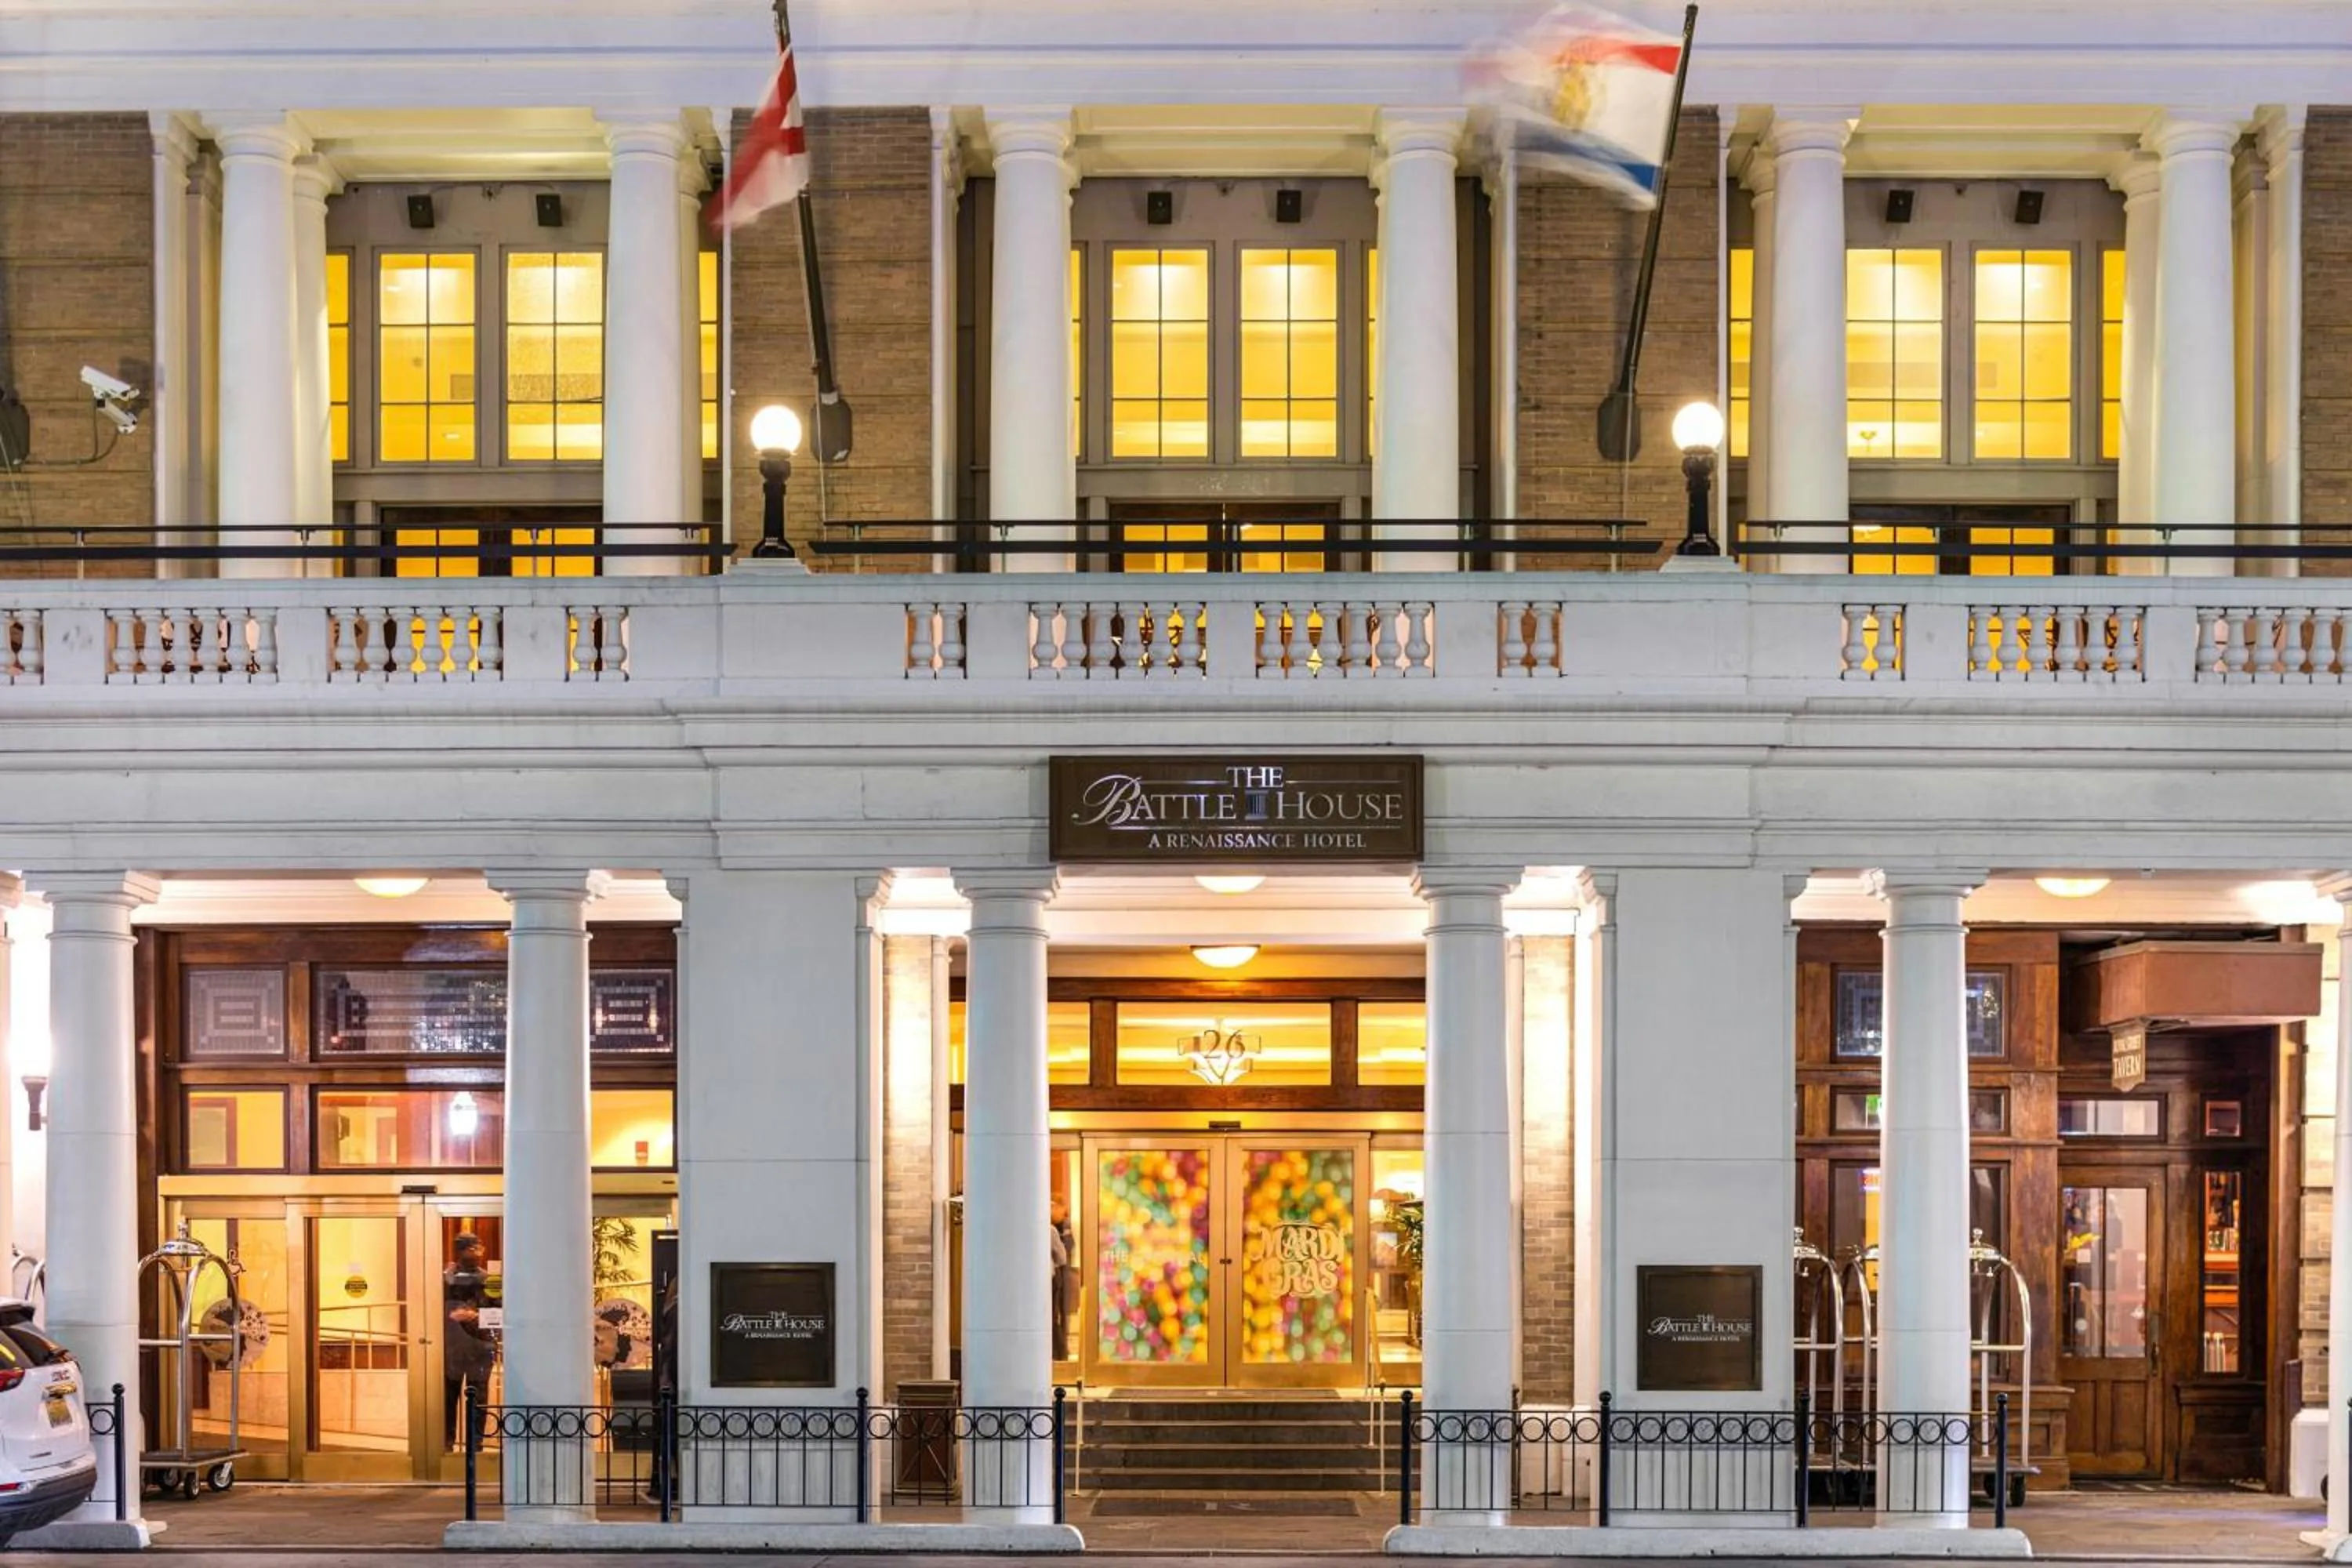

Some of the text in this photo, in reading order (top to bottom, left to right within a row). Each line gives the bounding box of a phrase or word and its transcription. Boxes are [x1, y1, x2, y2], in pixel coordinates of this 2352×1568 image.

[1225, 766, 1284, 789] THE
[1071, 774, 1403, 826] BATTLE HOUSE
[1148, 833, 1367, 849] A RENAISSANCE HOTEL
[1203, 1028, 1246, 1059] 26
[1252, 1221, 1345, 1262] MARDI
[1262, 1258, 1338, 1298] GRAS
[720, 1313, 826, 1330] BATTLE HOUSE
[1647, 1317, 1753, 1334] BATTLE HOUSE
